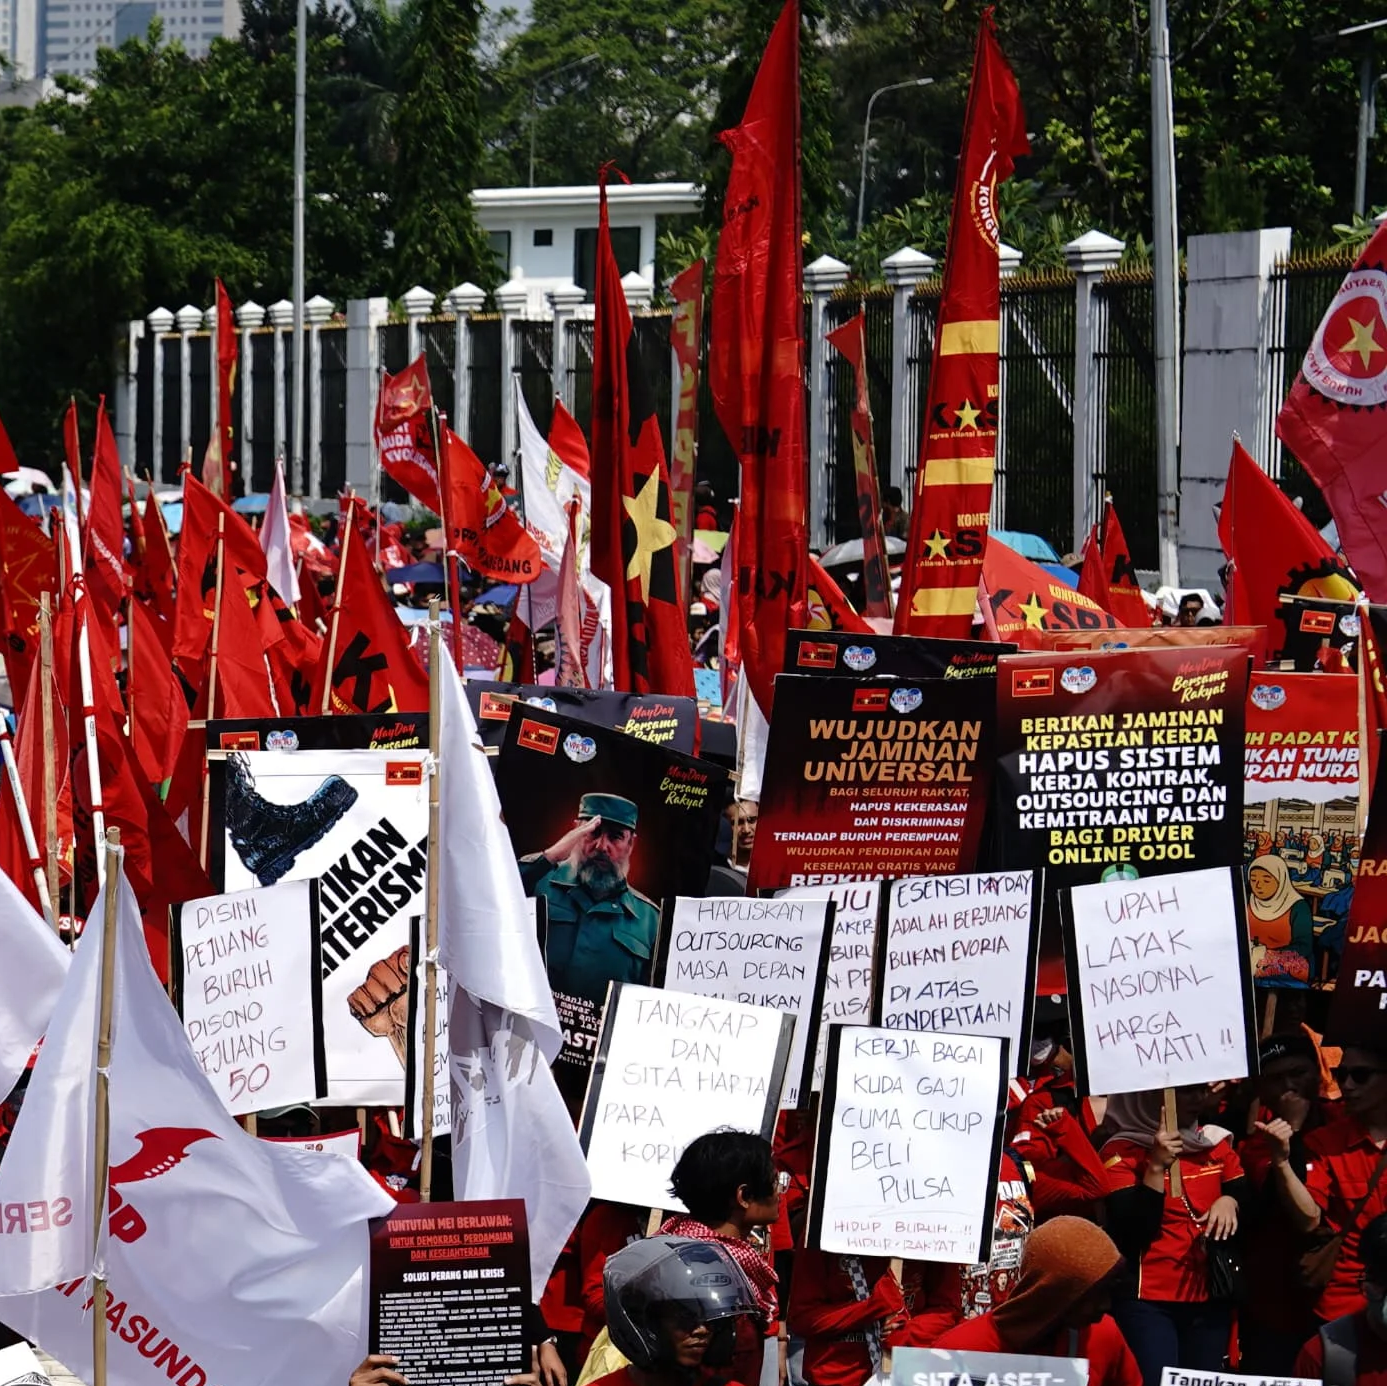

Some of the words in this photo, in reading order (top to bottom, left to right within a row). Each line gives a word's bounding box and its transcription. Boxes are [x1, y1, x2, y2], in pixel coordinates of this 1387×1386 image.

[624, 718, 678, 734] Bersama
[809, 720, 981, 741] WUJUDKAN
[1021, 715, 1114, 734] BERIKAN
[1123, 710, 1223, 729] JAMINAN
[1027, 732, 1143, 751] KEPASTIAN
[1152, 728, 1218, 745] KERJA
[1269, 732, 1339, 745] PADAT
[841, 742, 977, 760] JAMINAN
[1019, 751, 1109, 774] HAPUS
[1120, 745, 1220, 769] SISTEM
[804, 762, 973, 781] UNIVERSAL
[1031, 775, 1097, 791] KERJA
[1107, 768, 1214, 788] KONTRAK,
[660, 777, 708, 796] Bersama
[830, 788, 857, 796] BAGI
[862, 788, 917, 797] SELURUH
[921, 789, 969, 798] RAKYAT,
[665, 792, 704, 811] Rakyat
[850, 803, 890, 811] HAPUS
[894, 803, 968, 811] KEKERASAN
[1017, 789, 1173, 810] OUTSOURCING
[1182, 786, 1226, 803] DAN
[854, 818, 877, 826] DAN
[882, 818, 964, 826] DISKRIMINASI
[1020, 809, 1147, 829] KEMITRAAN
[1157, 805, 1224, 822] PALSU
[774, 832, 836, 841] TERHADAP
[840, 832, 881, 841] BURUH
[1051, 829, 1104, 846] BAGI
[1113, 826, 1193, 843] DRIVER
[786, 848, 854, 856] WUJUDKAN
[859, 848, 931, 856] PENDIDIKAN
[934, 848, 959, 856] DAN
[1049, 847, 1131, 864] ONLINE
[1139, 844, 1195, 860] OJOL
[803, 862, 873, 870] KESEHATAN
[877, 862, 920, 870] GRATIS
[924, 862, 956, 870] YANG
[197, 898, 257, 929] DISINI
[1105, 887, 1180, 924] UPAH
[186, 924, 269, 974] PEJUANG
[677, 932, 803, 952] OUTSOURCING
[1086, 929, 1192, 968] LAYAK
[677, 960, 728, 980] MASA
[744, 962, 805, 980] DEPAN
[204, 960, 273, 1005] BURUH
[915, 980, 979, 1000] ATAS
[1091, 964, 1214, 1008] NASIONAL
[188, 1001, 263, 1042] DISONO
[1096, 1011, 1181, 1049] HARGA
[854, 1037, 921, 1060] KERJA
[841, 1108, 902, 1129] CUMA
[913, 1110, 983, 1135] CUKUP
[879, 1175, 954, 1203] PULSA
[387, 1218, 435, 1232] TUNTUTAN
[457, 1215, 513, 1228] BERLAWAN:
[464, 1233, 513, 1243] PERDAMAIAN
[429, 1248, 488, 1258] KESEJAHTERAAN
[403, 1272, 429, 1282] SOLUSI
[431, 1271, 461, 1281] PERANG
[463, 1270, 478, 1279] DAN
[480, 1269, 505, 1278] KRISIS
